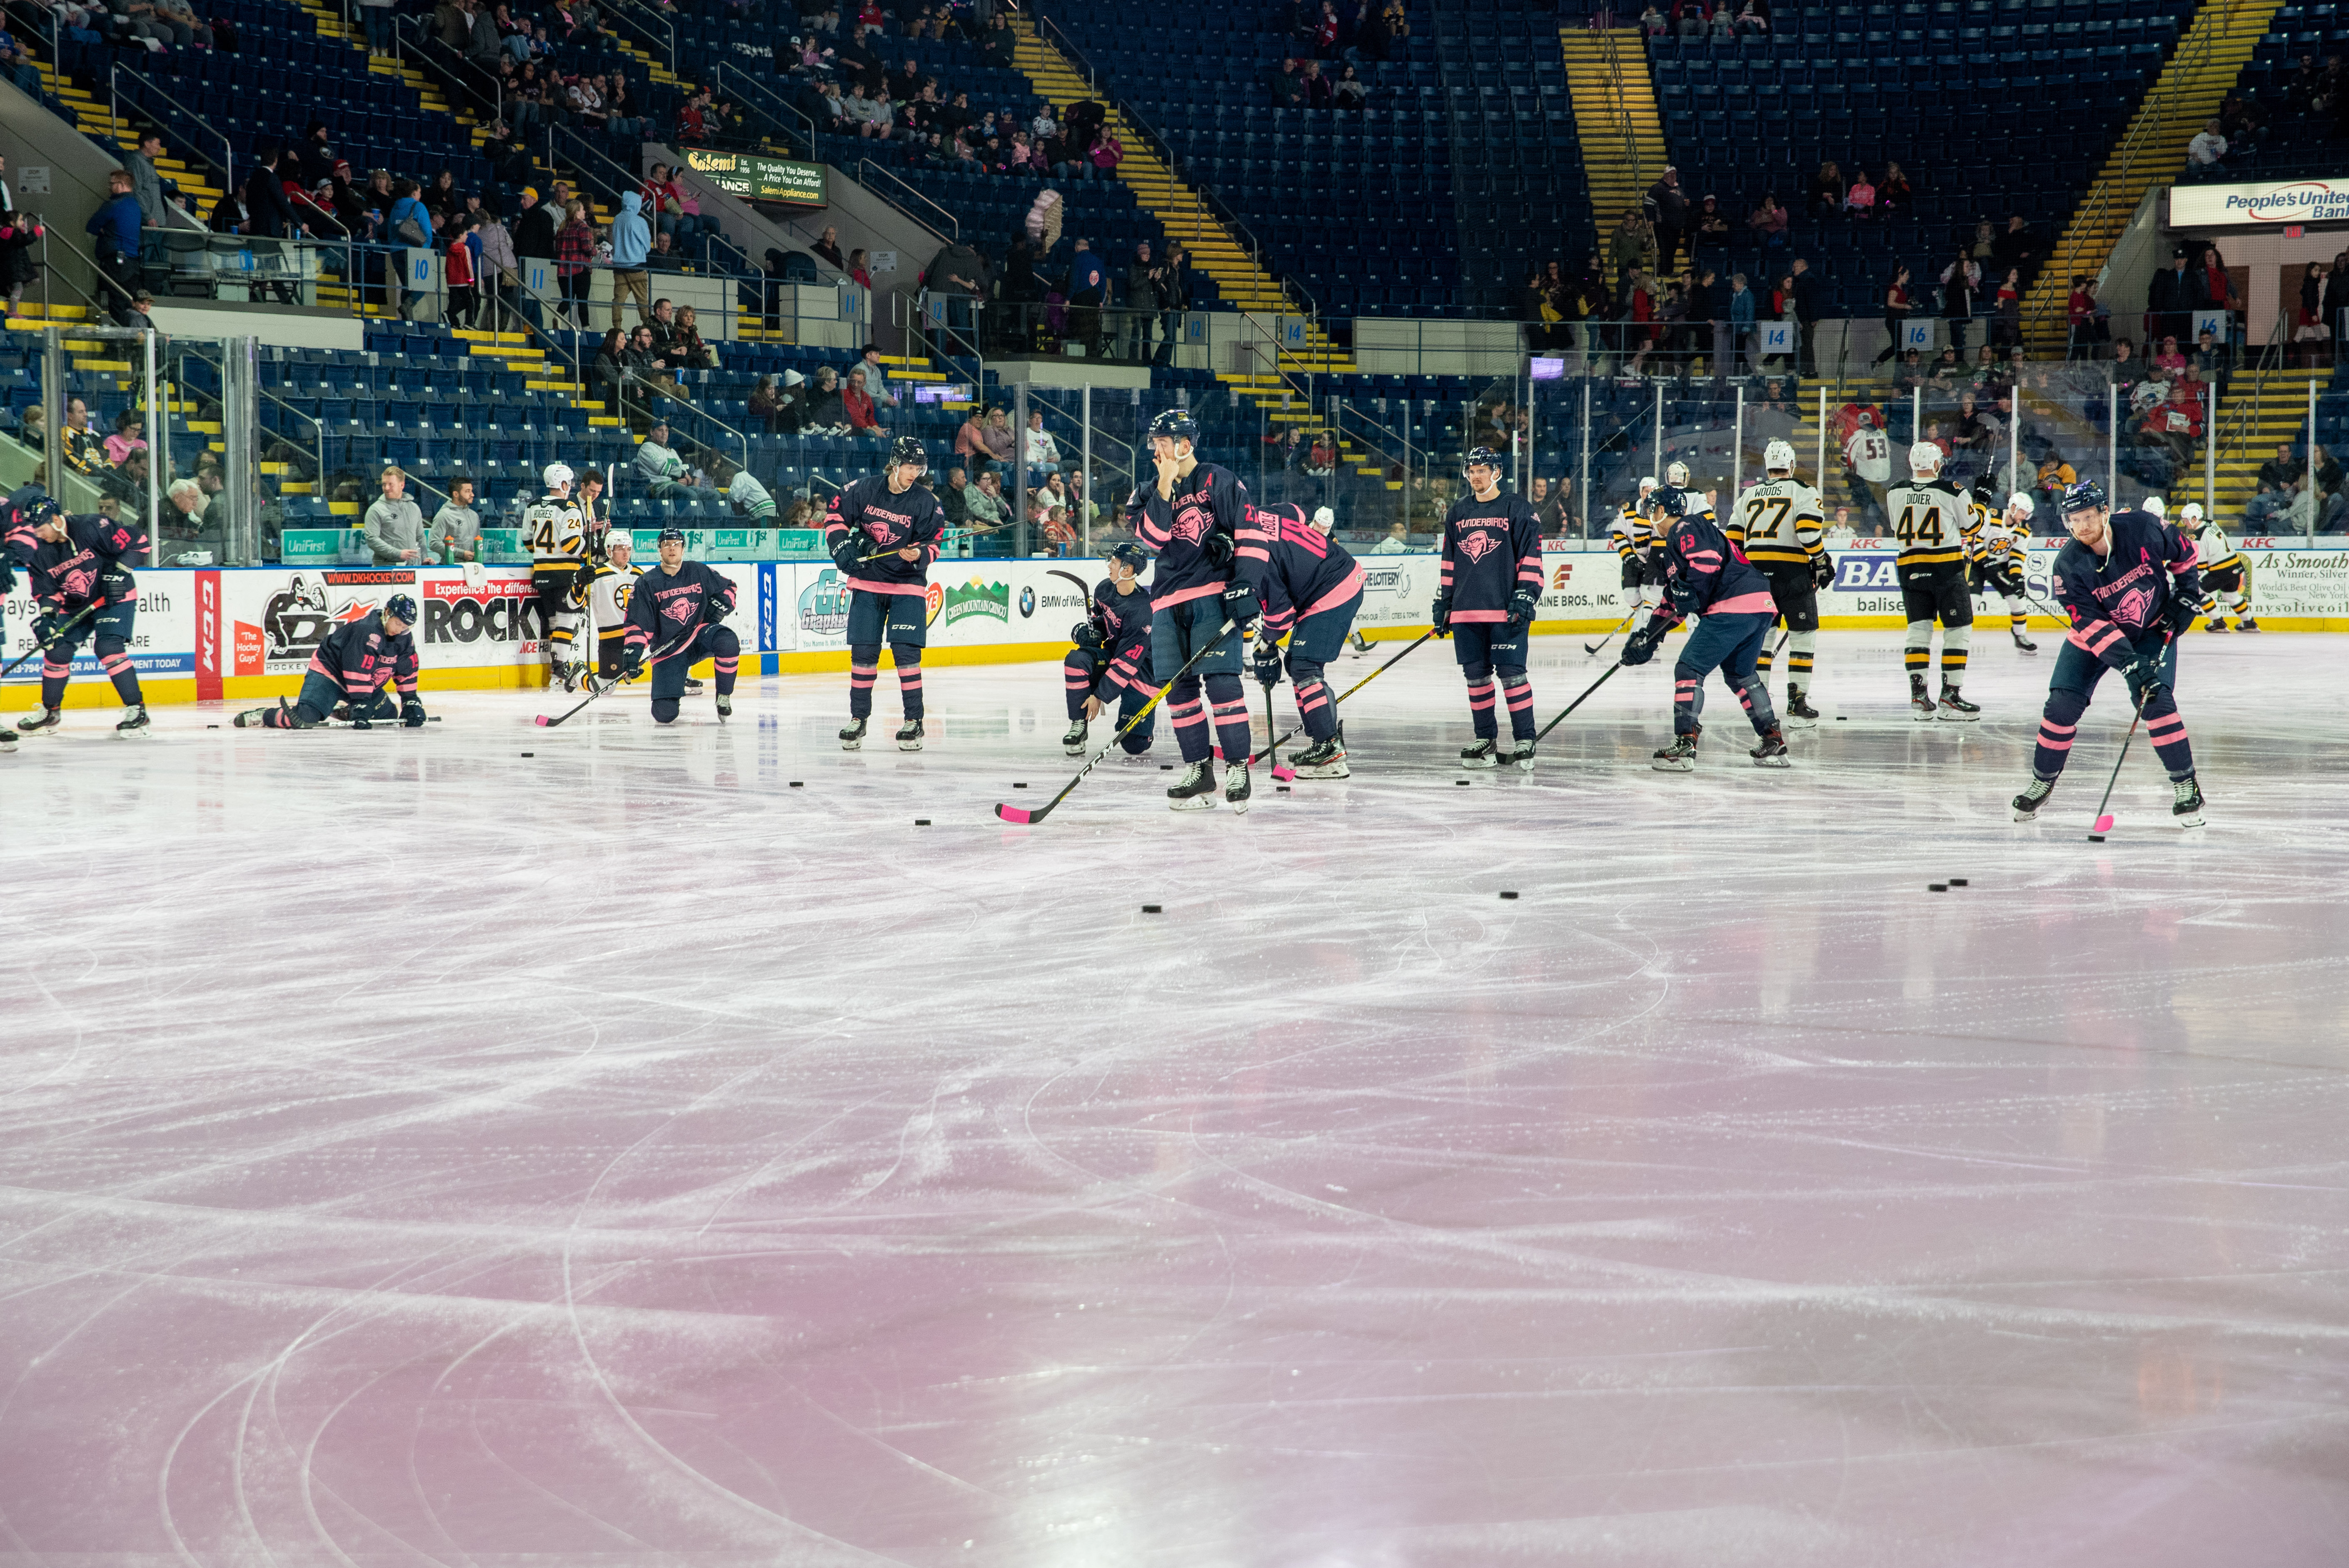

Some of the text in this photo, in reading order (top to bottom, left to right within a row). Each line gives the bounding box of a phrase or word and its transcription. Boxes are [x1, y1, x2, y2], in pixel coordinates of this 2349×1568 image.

[688, 152, 736, 171] Salemi
[757, 162, 766, 171] The
[768, 164, 785, 174] Quality
[797, 167, 820, 177] Deserve...
[761, 185, 819, 200] SalemiAppliance.com
[2226, 193, 2297, 210] People's
[2286, 225, 2302, 237] EXIT
[415, 259, 428, 280] 10
[532, 269, 544, 289] 11
[846, 295, 855, 312] 11
[934, 302, 942, 320] 12
[1191, 321, 1201, 337] 12
[1288, 324, 1301, 341] 14
[2202, 319, 2216, 334] 16
[1768, 330, 1785, 345] 14
[1910, 327, 1925, 342] 16
[1865, 438, 1887, 460] 53
[1204, 473, 1212, 487] A
[1755, 486, 1782, 497] WOODS
[1906, 493, 1931, 505] DIDIER
[829, 495, 841, 510] 5
[1815, 498, 1824, 510] 2
[1968, 504, 1975, 516] 4
[534, 509, 553, 519] HUGHES
[864, 504, 912, 528] HUNDERBIRDS
[1746, 497, 1792, 542] 27
[567, 518, 581, 529] 24
[1262, 514, 1276, 537] ABOLS
[1896, 505, 1945, 547] 44
[112, 528, 131, 550] 39
[718, 536, 740, 545] UniFirst
[934, 527, 944, 540] 2
[1281, 518, 1327, 559] 18
[288, 539, 326, 552] UniFirst
[782, 537, 809, 549] UniFirst
[832, 539, 851, 556] CCM
[1547, 540, 1566, 551] KFC
[1680, 534, 1695, 553] 63
[1850, 539, 1882, 549] KFC
[1997, 539, 2009, 552] P
[2044, 537, 2069, 548] KF
[2242, 538, 2276, 549] KFC
[2140, 547, 2150, 563] A
[2256, 553, 2280, 569] As
[2285, 552, 2349, 569] Smooth
[327, 572, 415, 584] WWW.DKHOCKEY.COM
[1374, 572, 1400, 586] LOTTERY
[2277, 569, 2348, 579] Winner, Silver
[435, 583, 485, 597] Experience
[487, 582, 502, 594] the
[2092, 563, 2154, 603] THUNDERBIRDS
[654, 582, 702, 602] THUNDERBIRDS
[1224, 588, 1249, 599] CM
[136, 592, 171, 612] alth
[710, 598, 728, 612] CM
[1041, 596, 1061, 607] BMW
[1062, 596, 1069, 607] of
[1070, 595, 1085, 607] Wes
[1562, 595, 1594, 607] BROS.,
[1597, 594, 1618, 605] INC.
[948, 600, 1007, 620] GREEN MOUNTAIN GRINGO
[2026, 604, 2066, 614] SPRING
[2066, 604, 2082, 623] 2
[2220, 601, 2349, 616] mnysoliveoil
[203, 579, 214, 672] CCM
[801, 608, 849, 635] Graphix
[128, 636, 150, 648] ARE
[236, 643, 261, 653] Hockey
[520, 642, 537, 654] ACE
[1125, 644, 1143, 660] 20
[2158, 644, 2168, 662] CCM
[71, 662, 82, 672] OR
[83, 662, 95, 671] AN
[155, 659, 181, 668] TODAY
[267, 663, 308, 671] HOCKEY
[361, 654, 375, 670] 19
[1257, 657, 1278, 667] CC
[1337, 691, 1351, 703] SUPER
[1126, 716, 1141, 732] SUPER
[1079, 742, 1114, 782] CCM
